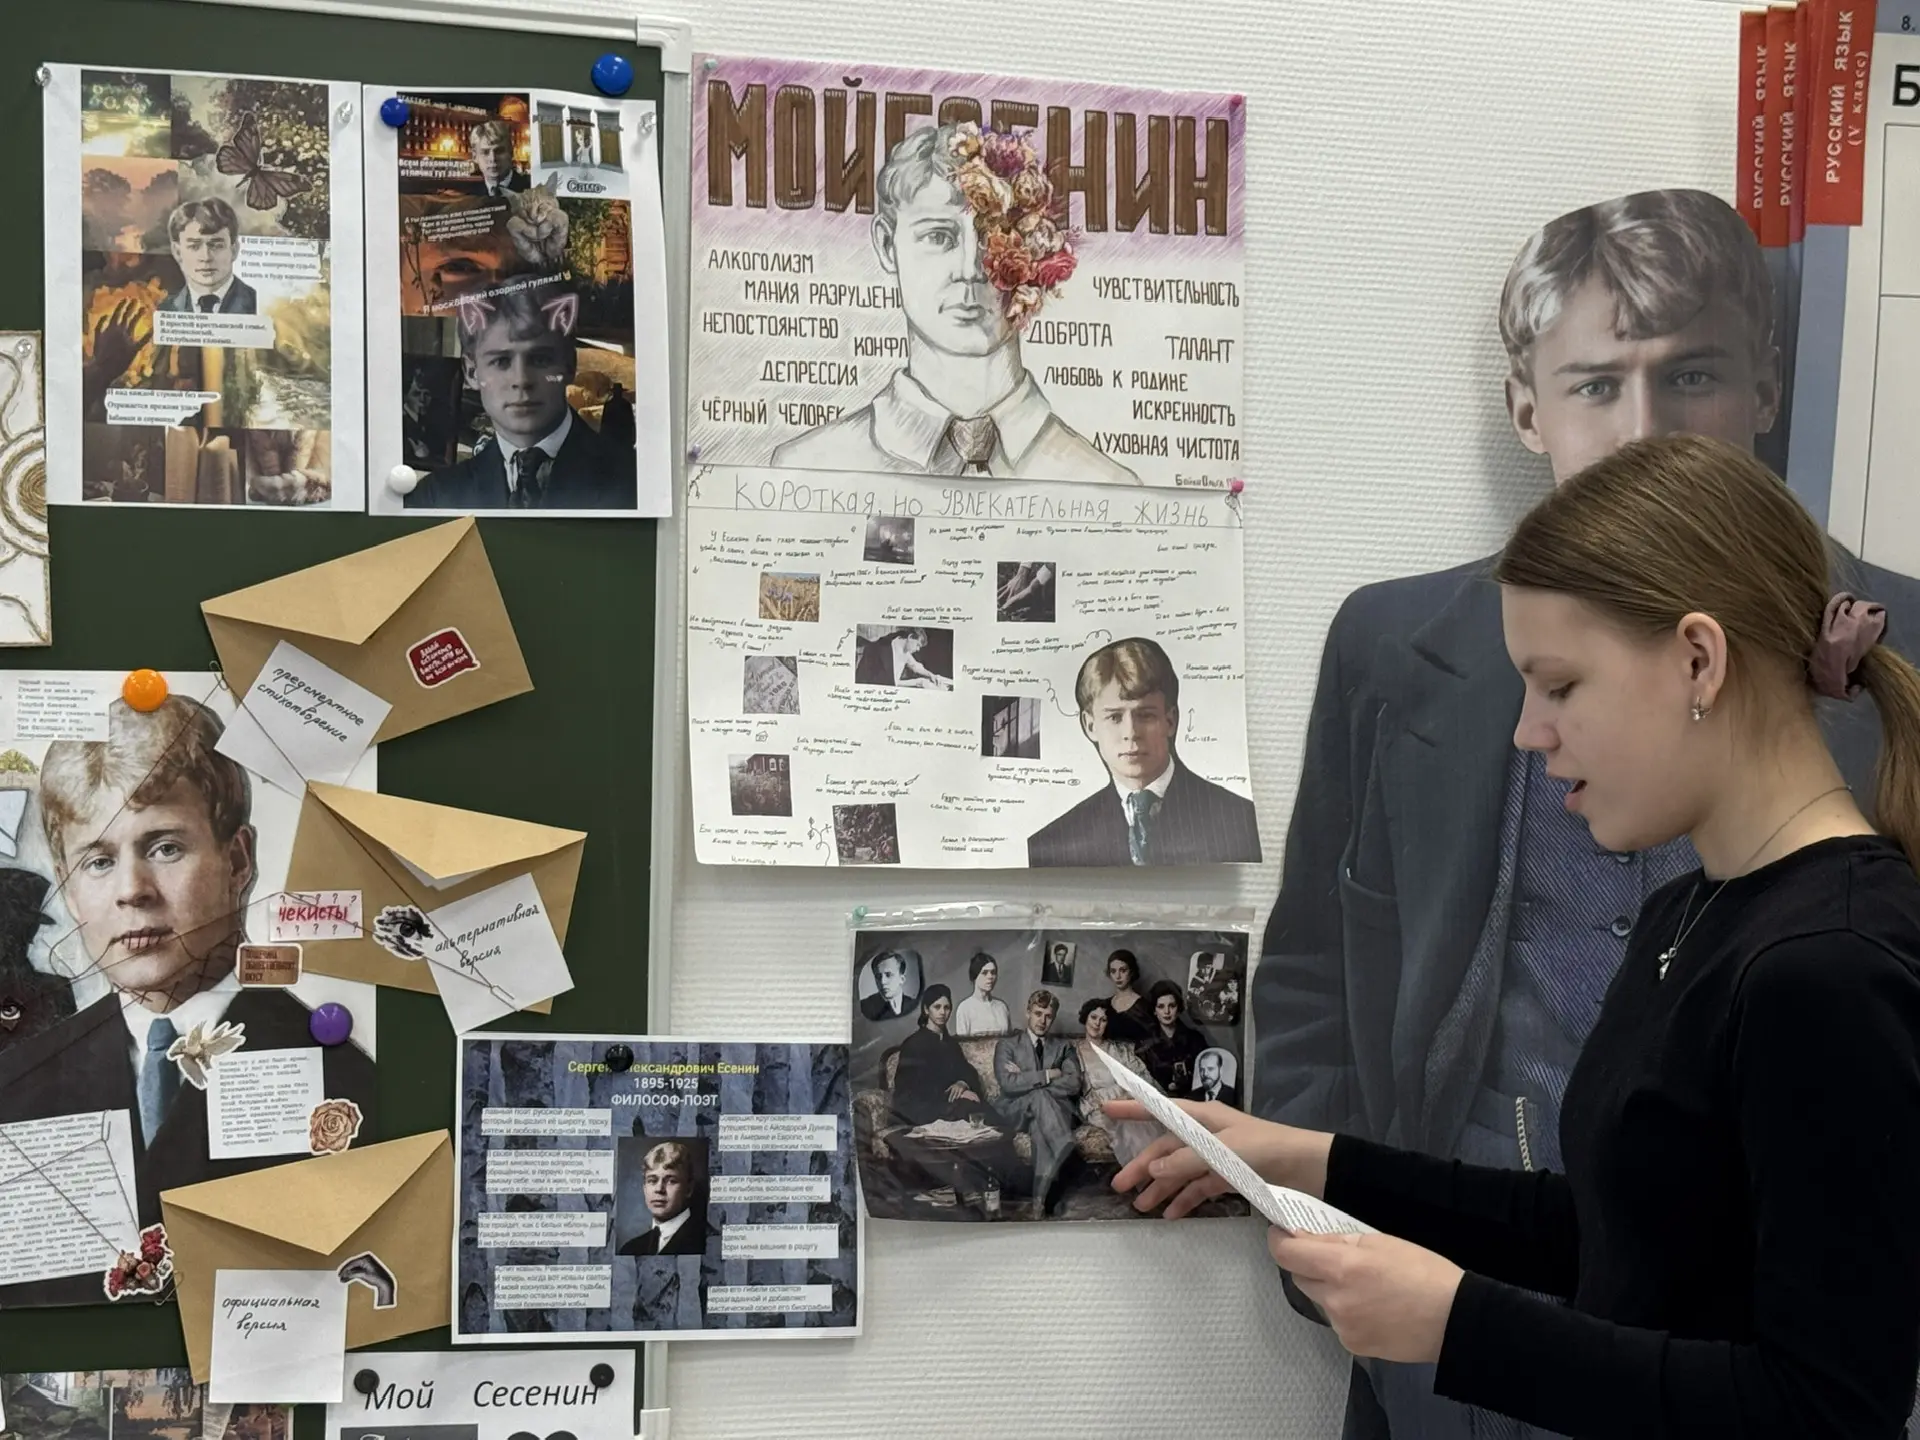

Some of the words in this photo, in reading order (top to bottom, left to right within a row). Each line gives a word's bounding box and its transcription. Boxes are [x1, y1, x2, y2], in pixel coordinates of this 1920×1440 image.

[1834, 11, 1853, 71] ЯЗЫК
[1783, 41, 1797, 98] ЯЗЫК
[1852, 50, 1868, 114] класс)
[707, 76, 875, 214] МОЙ
[1826, 85, 1846, 183] РУССКИЙ
[1779, 112, 1795, 206] РУССКИЙ
[708, 249, 814, 274] АЛКОГОЛИЗМ
[489, 281, 527, 298] озорной
[744, 280, 801, 303] МАНИЯ
[1092, 277, 1240, 307] ЧУВСТВИТЕЛЬНОСТЬ
[703, 314, 839, 340] НЕПОСТОЯНСТВО
[1025, 321, 1113, 347] ДОБРОТА
[1165, 335, 1235, 364] ТАЛАНТ
[760, 360, 859, 387] ДЕПРЕССИЯ
[1044, 366, 1104, 388] ЛЮБОВЬ
[1113, 369, 1124, 389] К
[1131, 369, 1188, 393] РОДИНЕ
[702, 397, 767, 425] ЧЁРНЫЙ
[1132, 401, 1236, 427] ИСКРЕННОСТЬ
[1177, 437, 1240, 461] ЧИСТОТА
[939, 488, 1109, 521] УВЛЕКАТЕЛЬНАЯ
[1134, 500, 1208, 527] ЖИЗНЬ
[256, 682, 348, 743] стихотворение
[717, 1063, 760, 1074] Есенин
[634, 1078, 698, 1090] 1895-1925
[611, 1094, 718, 1106] ФИЛОСОФ-ПОЭТ
[222, 1296, 321, 1319] официальная
[236, 1313, 288, 1340] версия
[364, 1380, 434, 1410] Мой
[474, 1380, 599, 1407] Сесенин
